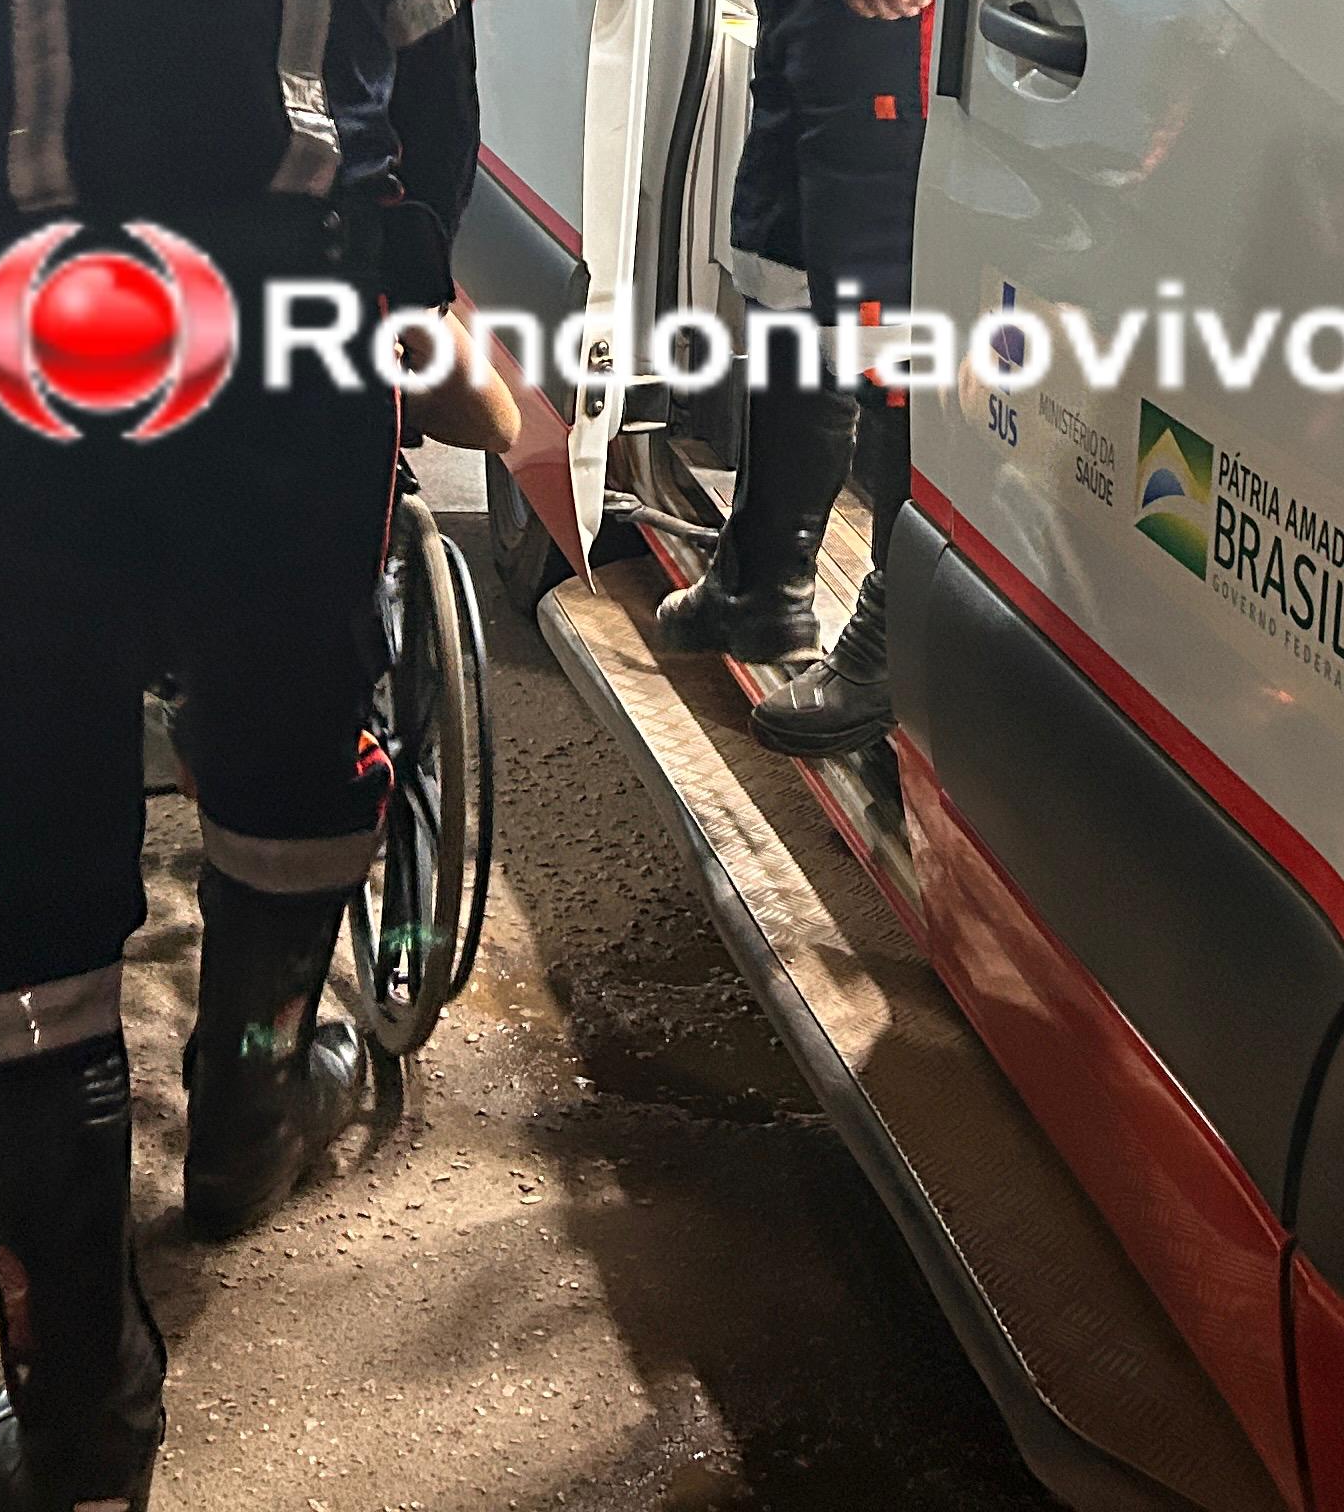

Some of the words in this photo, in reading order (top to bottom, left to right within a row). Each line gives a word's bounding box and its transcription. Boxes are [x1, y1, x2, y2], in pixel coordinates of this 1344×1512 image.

[988, 393, 1018, 448] SUS
[1038, 391, 1098, 457] MINISTÉRIO
[1099, 436, 1115, 472] DA
[1075, 455, 1114, 508] SAÚDE
[1218, 451, 1280, 525] PÁTRIA
[1212, 573, 1277, 637] GOVERNO
